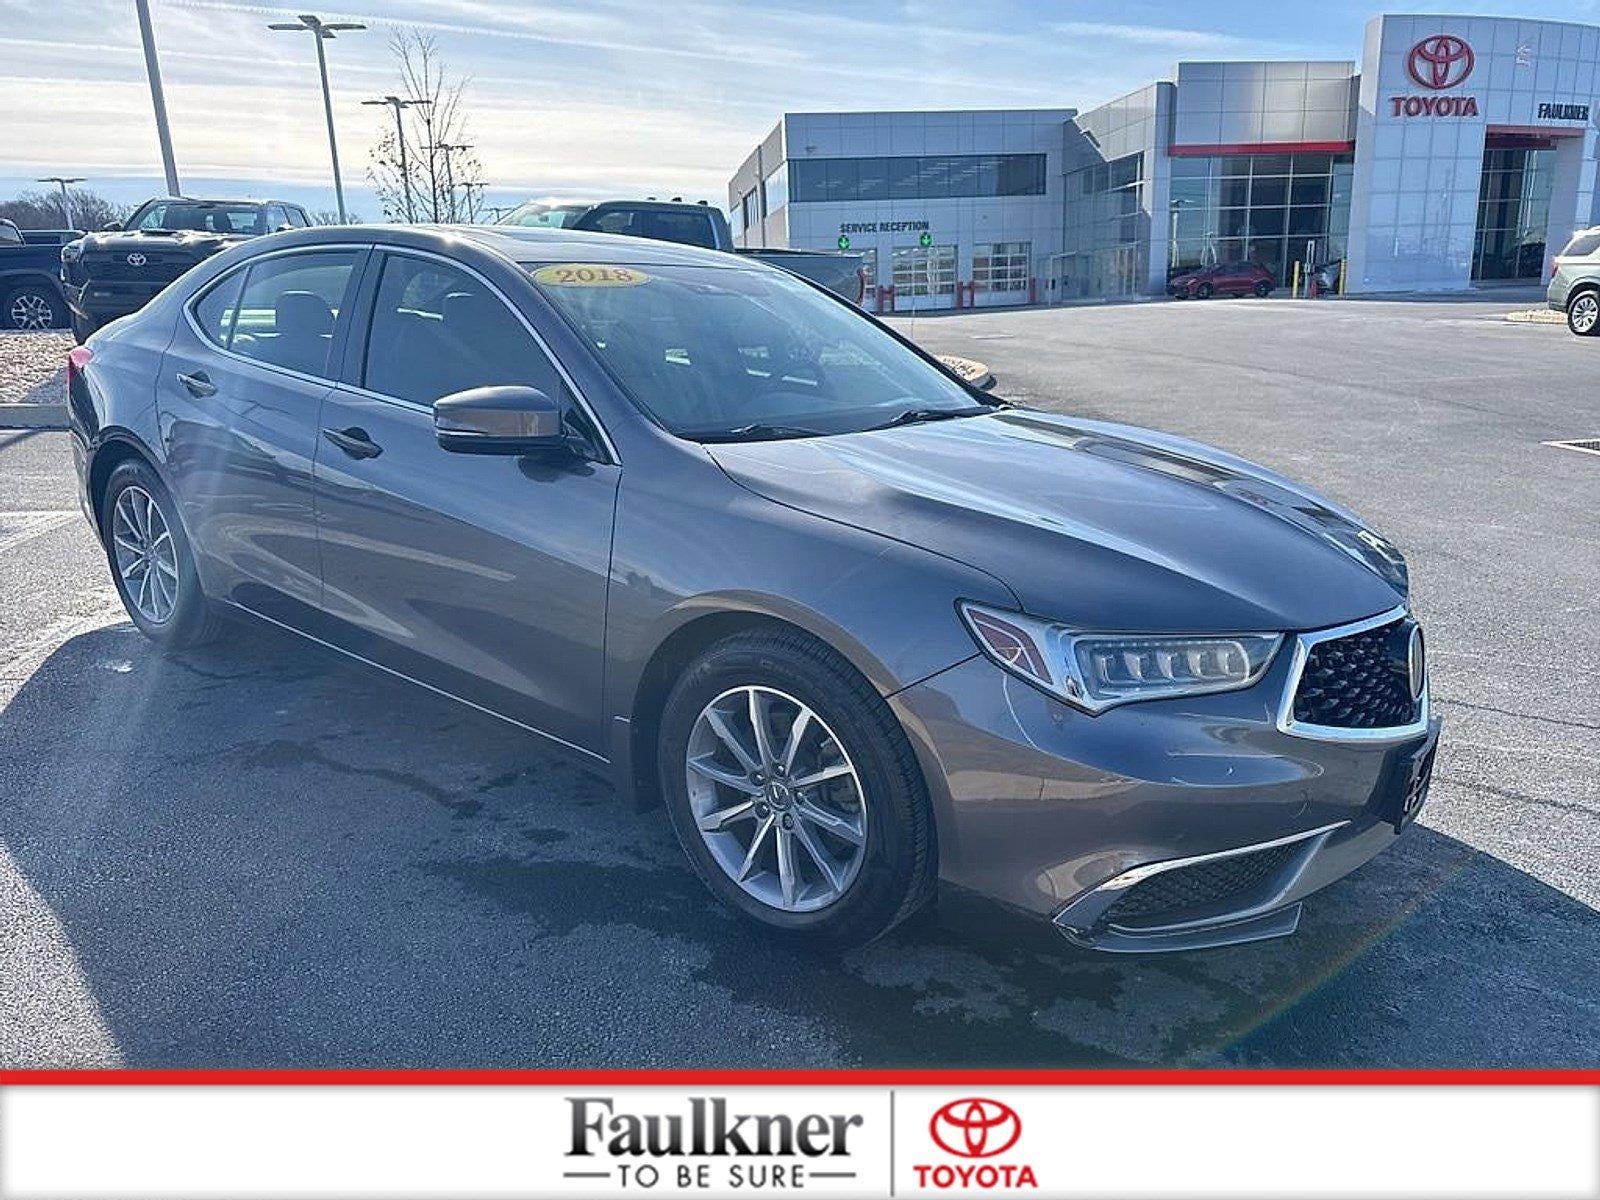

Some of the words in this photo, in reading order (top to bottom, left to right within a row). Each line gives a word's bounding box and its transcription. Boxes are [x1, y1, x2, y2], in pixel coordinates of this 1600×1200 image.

[1390, 96, 1479, 117] TOYOTA
[1538, 103, 1589, 121] FAULKNER
[840, 223, 877, 233] SERVICE
[879, 221, 929, 232] RECEPTION
[555, 268, 633, 283] 2018
